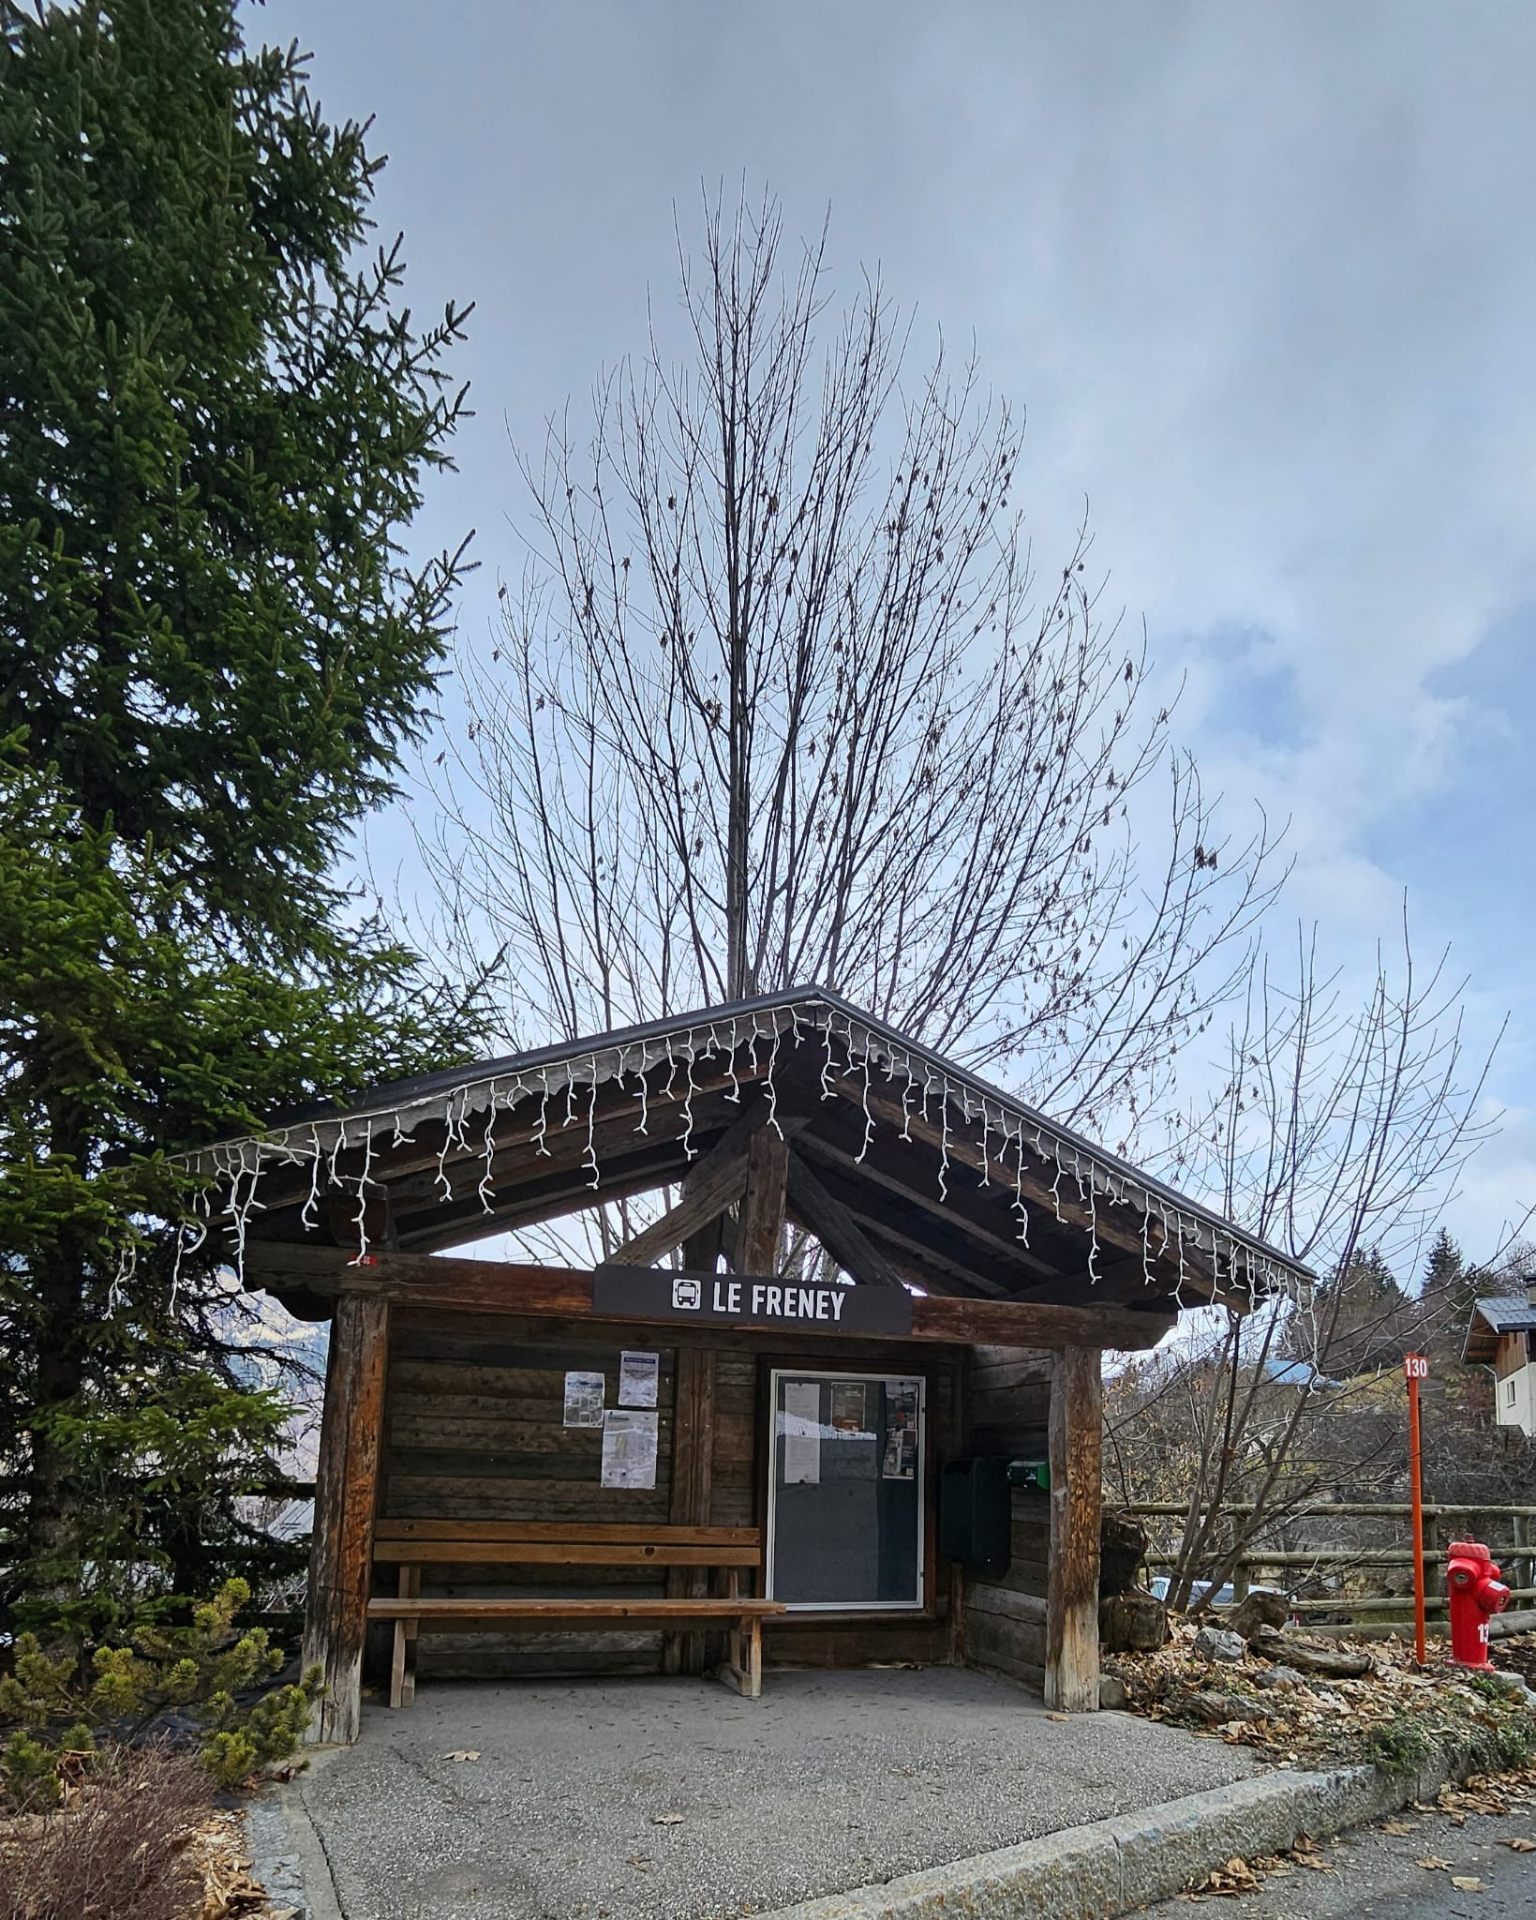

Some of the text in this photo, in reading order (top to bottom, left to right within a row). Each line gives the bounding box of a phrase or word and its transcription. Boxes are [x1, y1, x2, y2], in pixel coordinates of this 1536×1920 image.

[713, 1281, 846, 1321] LE FRENEY
[1405, 1358, 1427, 1377] 130
